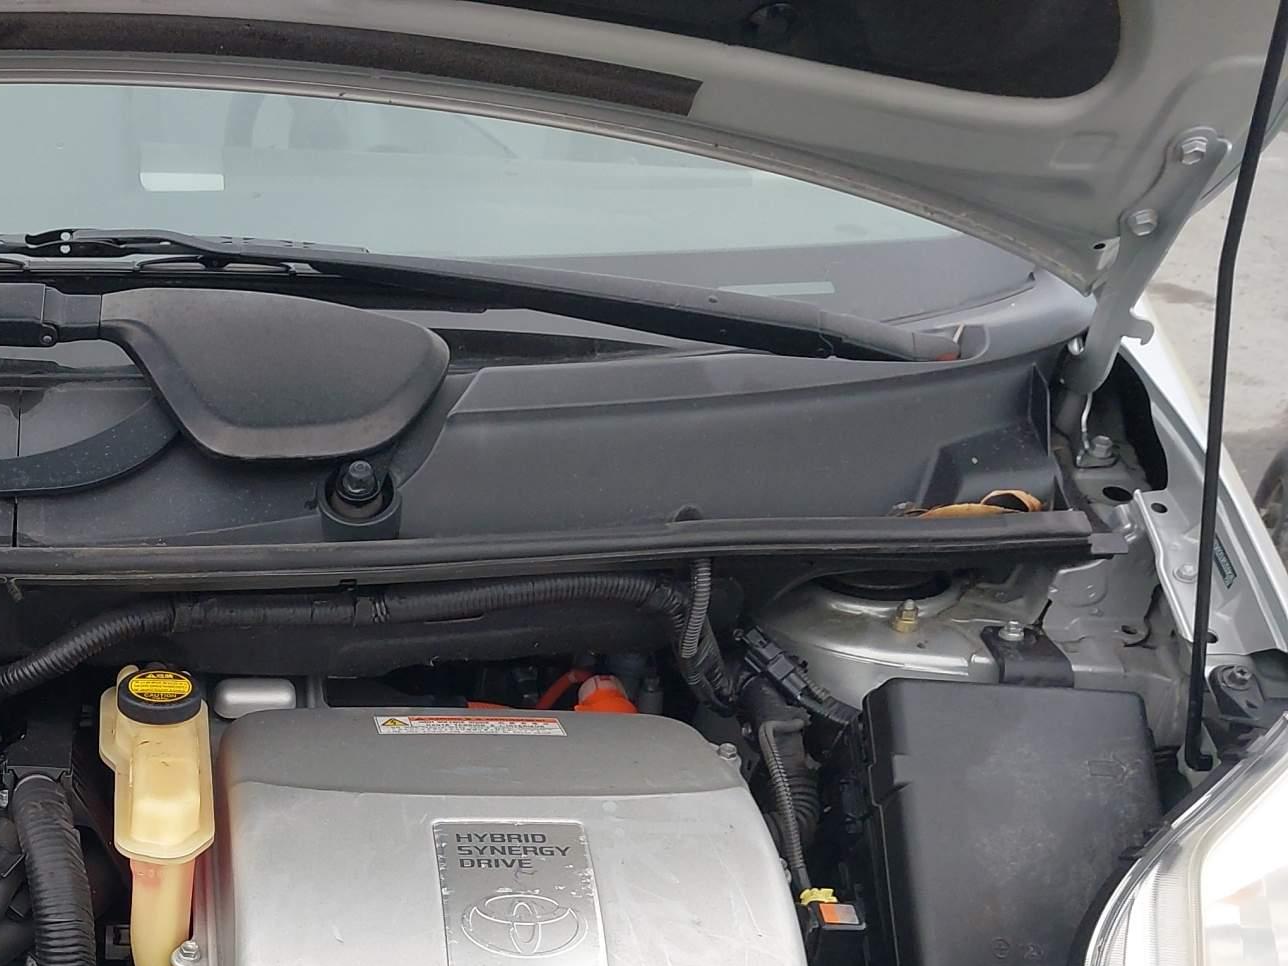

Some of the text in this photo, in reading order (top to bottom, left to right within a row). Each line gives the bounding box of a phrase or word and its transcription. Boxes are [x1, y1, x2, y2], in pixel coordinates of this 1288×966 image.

[455, 833, 547, 844] HYBRID
[457, 845, 572, 857] SYNERGY
[459, 858, 534, 869] DRIVE
